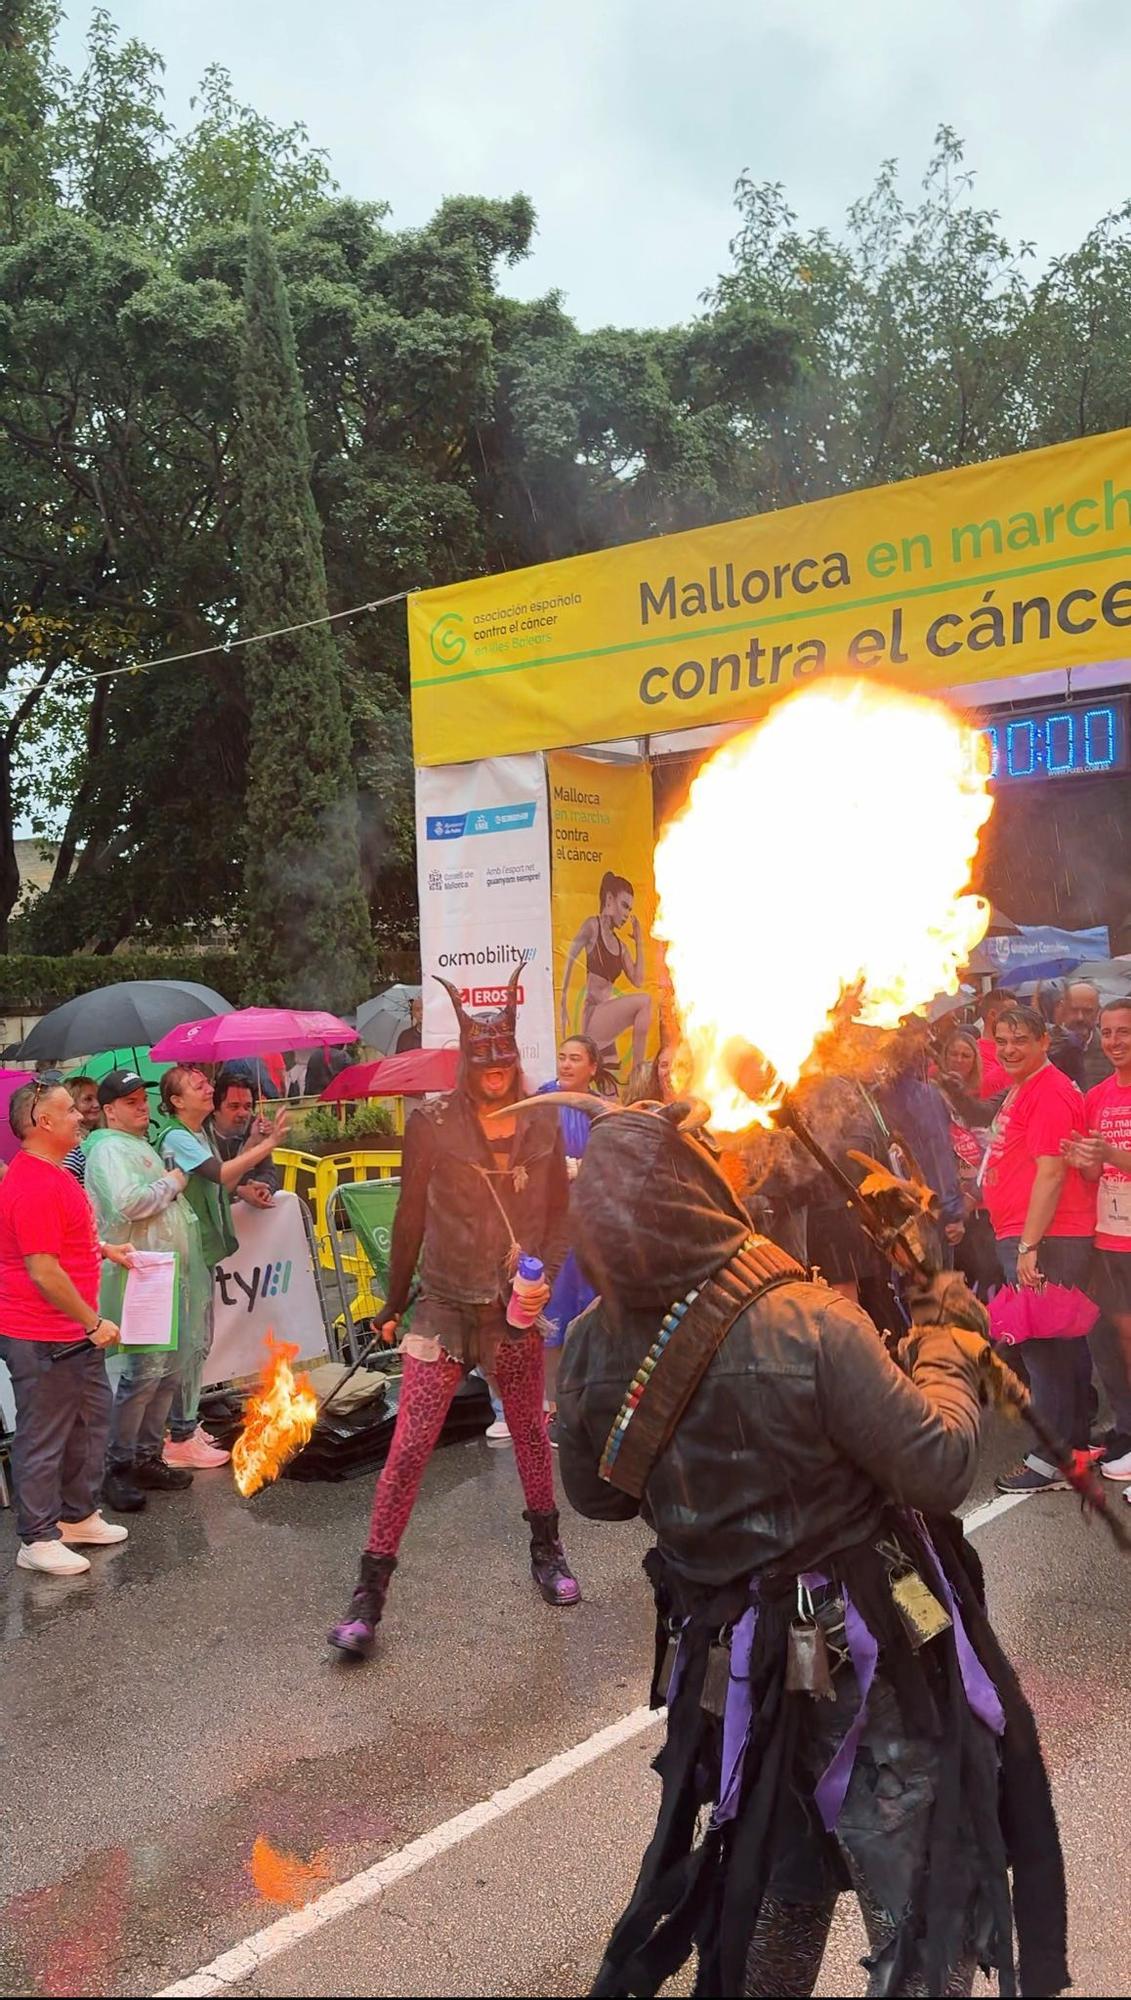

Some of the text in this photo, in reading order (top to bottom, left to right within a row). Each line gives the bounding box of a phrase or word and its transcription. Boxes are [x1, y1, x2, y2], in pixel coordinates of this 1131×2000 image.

[639, 552, 851, 625] Mallorca
[866, 533, 933, 578] en
[473, 593, 582, 624] asociación española
[473, 615, 559, 640] contra el cáncer
[639, 638, 827, 705] contra
[847, 608, 909, 668] el
[554, 786, 601, 805] Mallorca
[554, 808, 610, 825] en marcha
[555, 828, 589, 842] contra
[556, 846, 603, 863] el cáncer
[474, 989, 521, 1004] EROSI
[215, 1265, 261, 1313] ty
